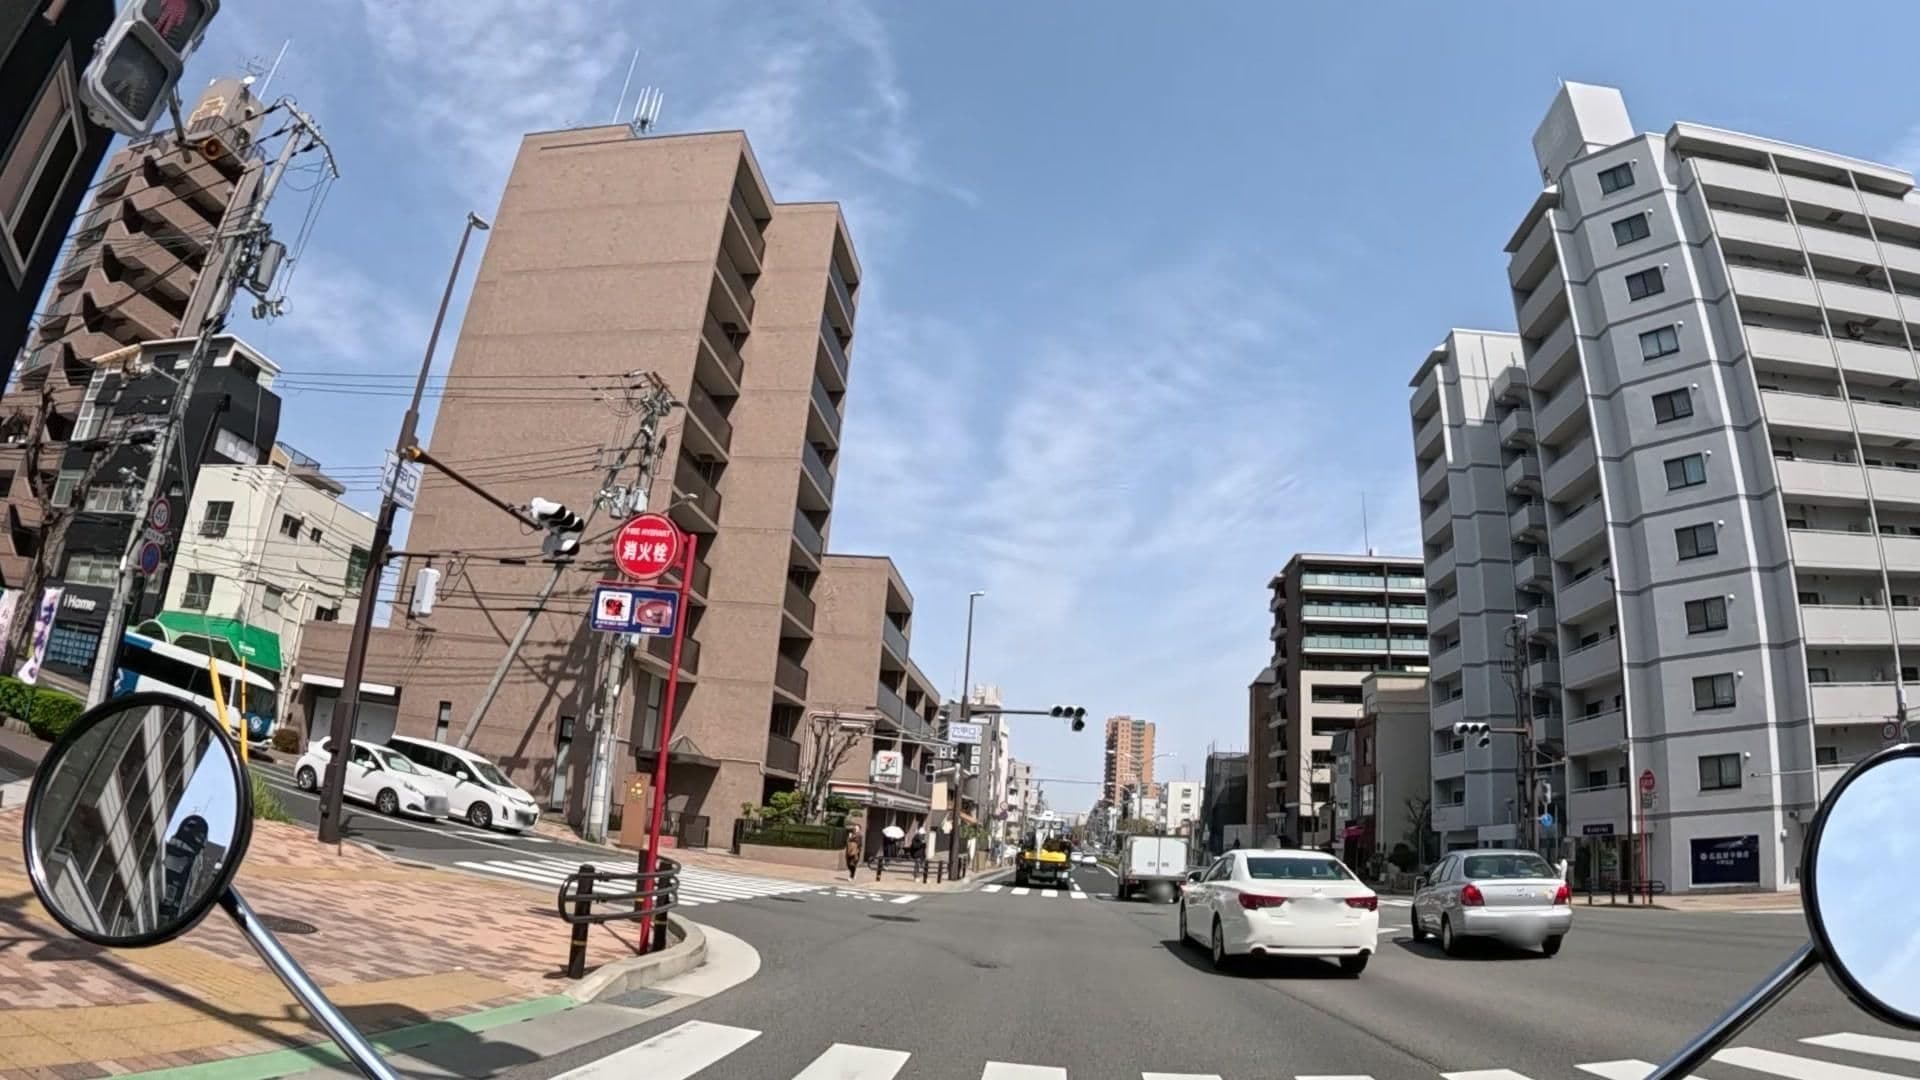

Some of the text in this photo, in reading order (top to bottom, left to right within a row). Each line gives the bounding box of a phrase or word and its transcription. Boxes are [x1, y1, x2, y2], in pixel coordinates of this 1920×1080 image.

[622, 540, 669, 563] 消火栓
[68, 594, 97, 611] Home
[952, 726, 977, 736] 六甲口
